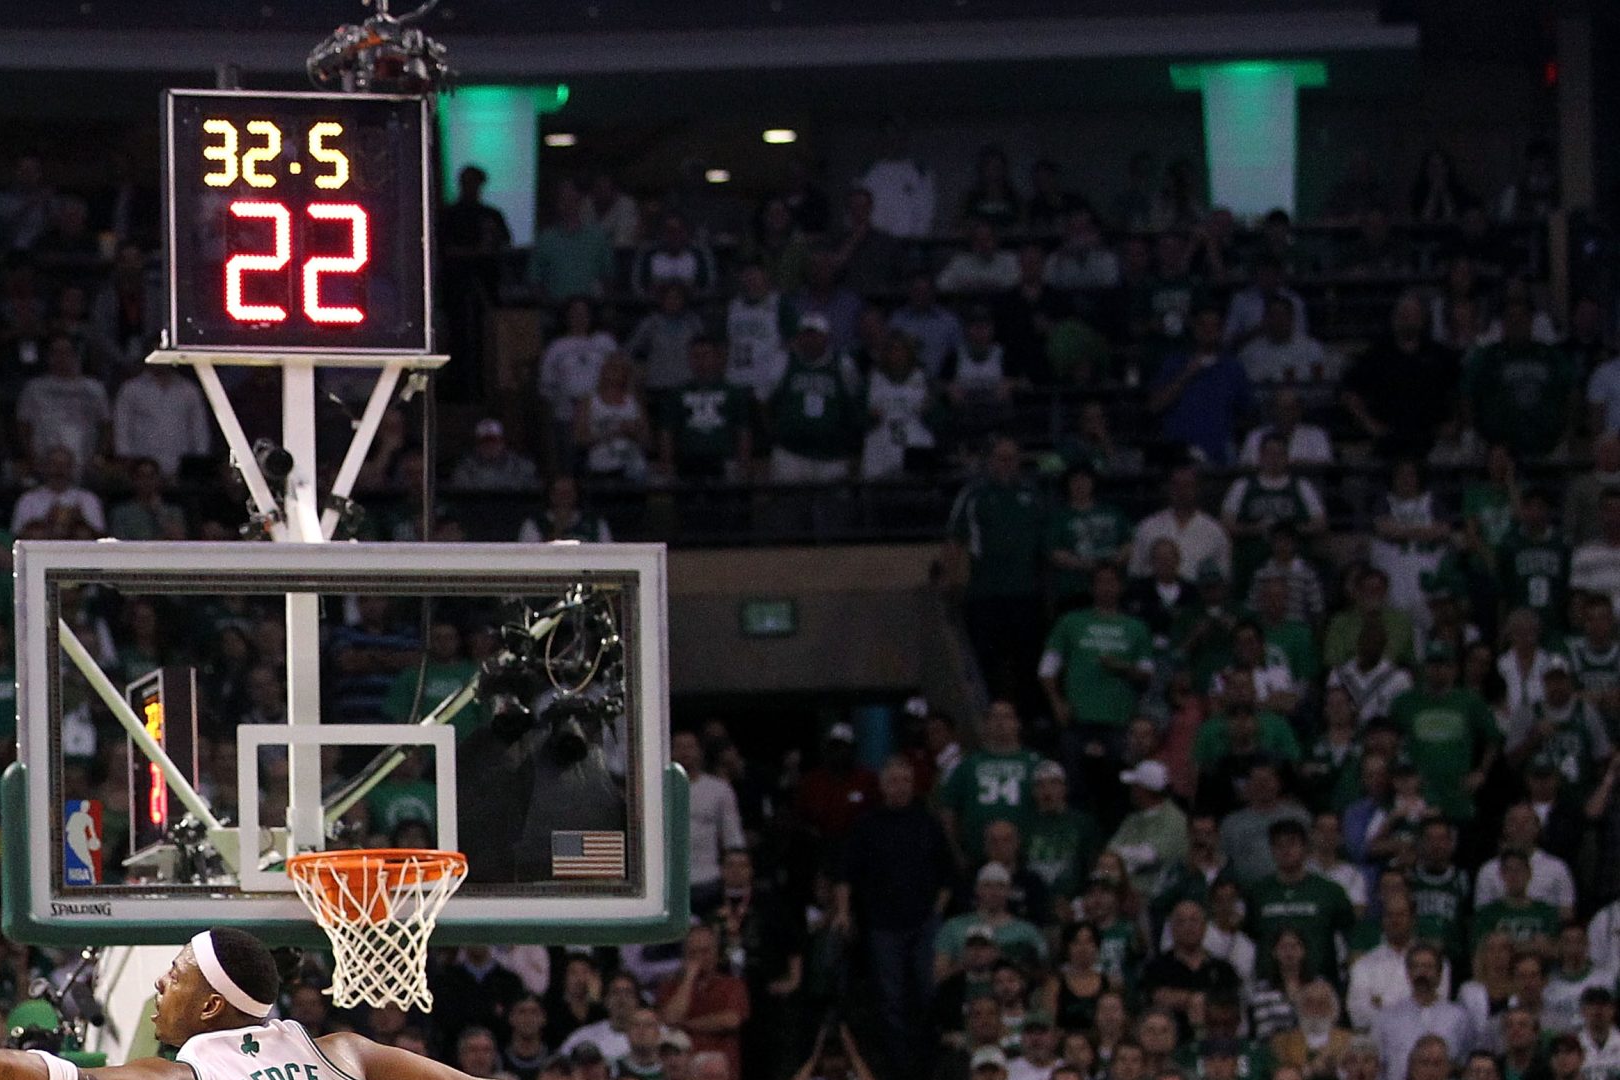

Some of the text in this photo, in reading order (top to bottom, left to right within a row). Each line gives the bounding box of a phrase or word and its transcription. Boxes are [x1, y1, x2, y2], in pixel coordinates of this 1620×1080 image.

[203, 119, 349, 189] 32.5
[225, 201, 368, 323] 22
[50, 902, 112, 917] SPALDING
